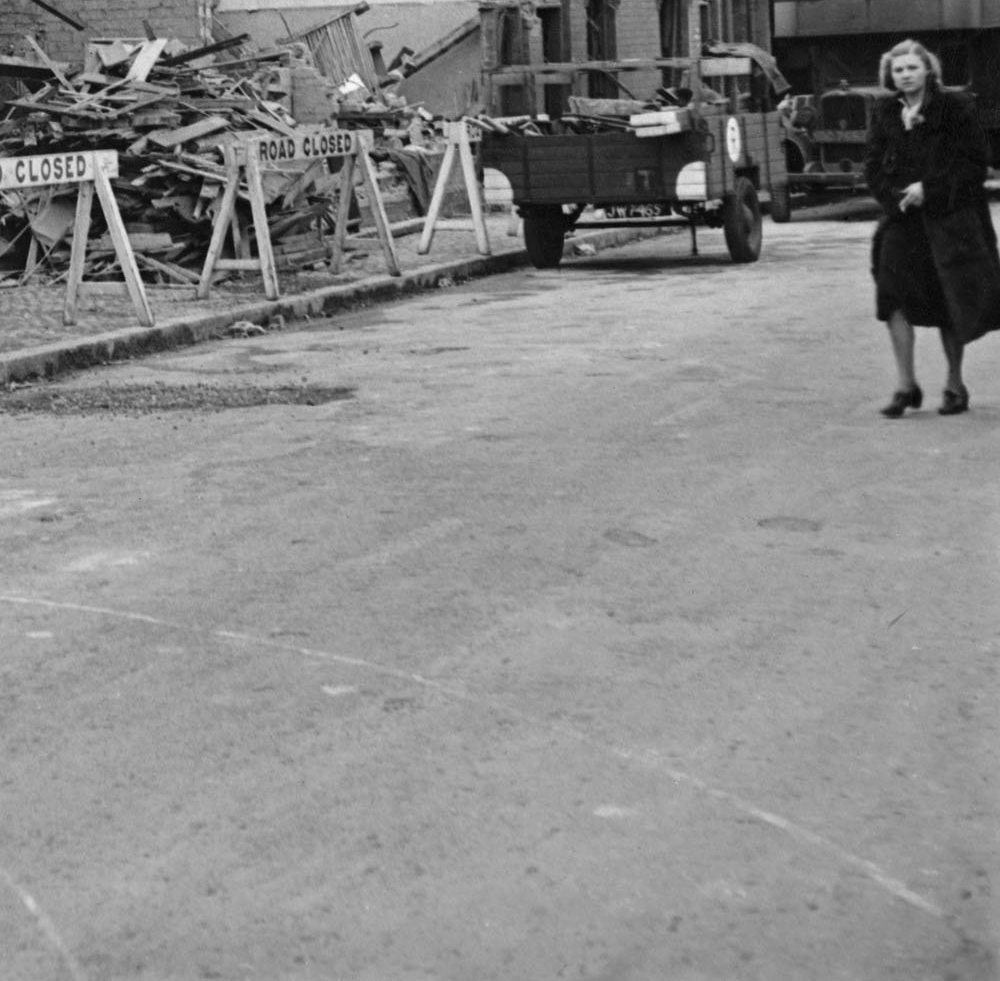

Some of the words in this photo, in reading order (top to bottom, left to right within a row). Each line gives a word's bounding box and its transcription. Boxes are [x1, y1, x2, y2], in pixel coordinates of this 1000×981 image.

[259, 139, 295, 161] ROAD
[303, 133, 352, 157] CLOSED
[15, 155, 87, 183] CLOSED
[607, 205, 627, 218] JW
